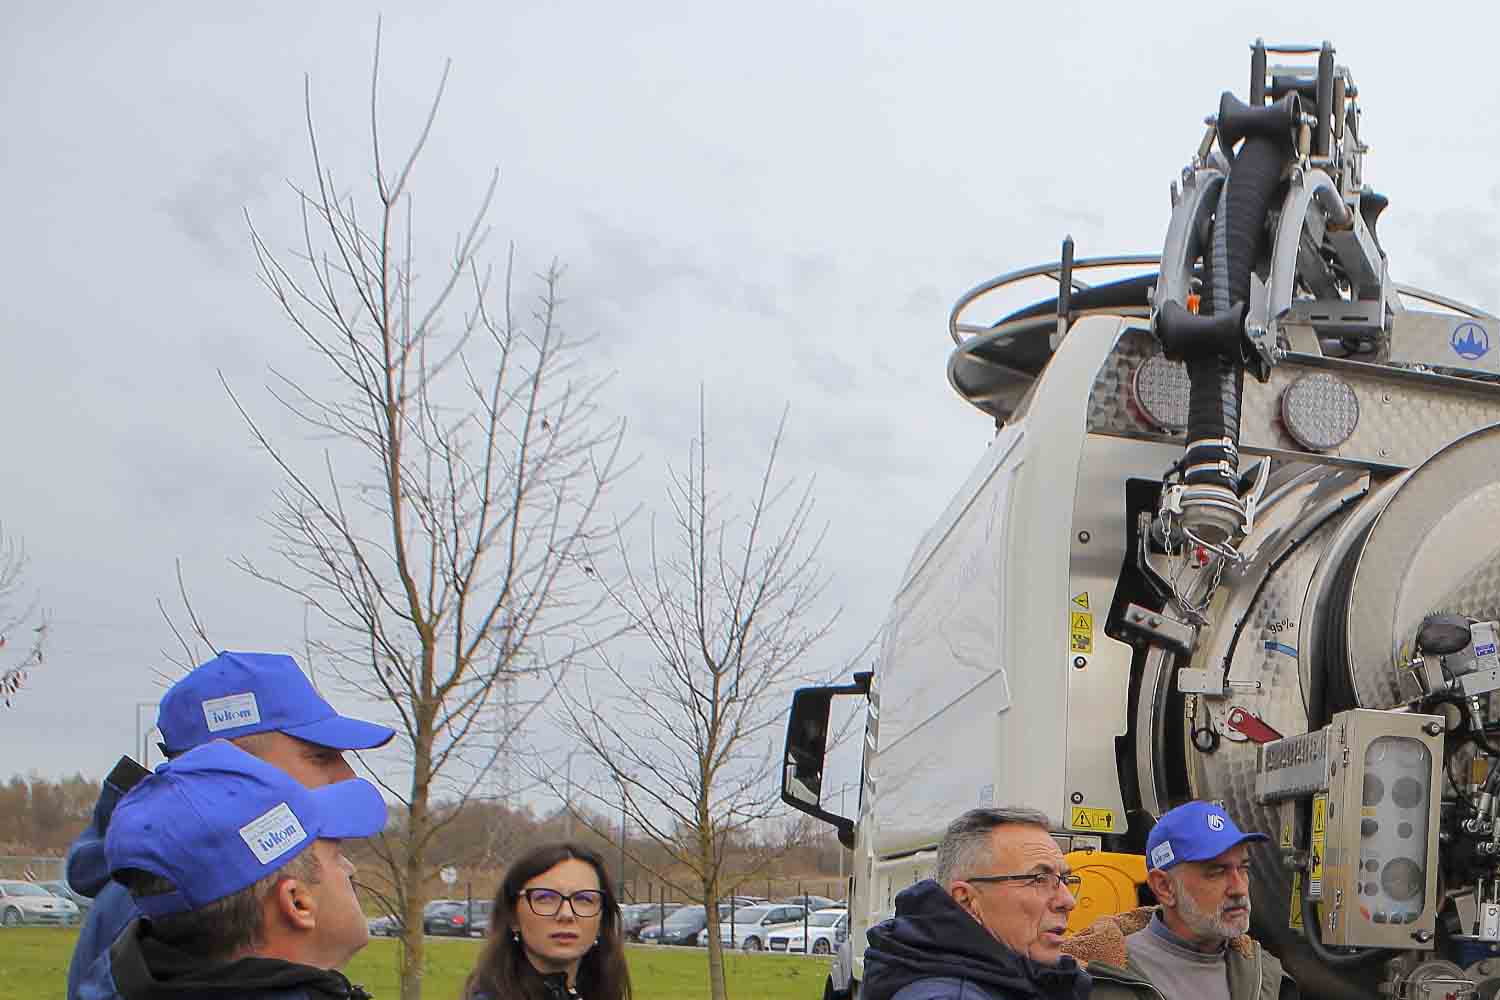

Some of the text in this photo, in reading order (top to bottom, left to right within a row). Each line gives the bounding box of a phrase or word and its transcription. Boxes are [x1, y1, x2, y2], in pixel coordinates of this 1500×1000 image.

[1270, 617, 1294, 633] 95%
[213, 709, 251, 723] ivkom
[257, 824, 297, 851] ivkom
